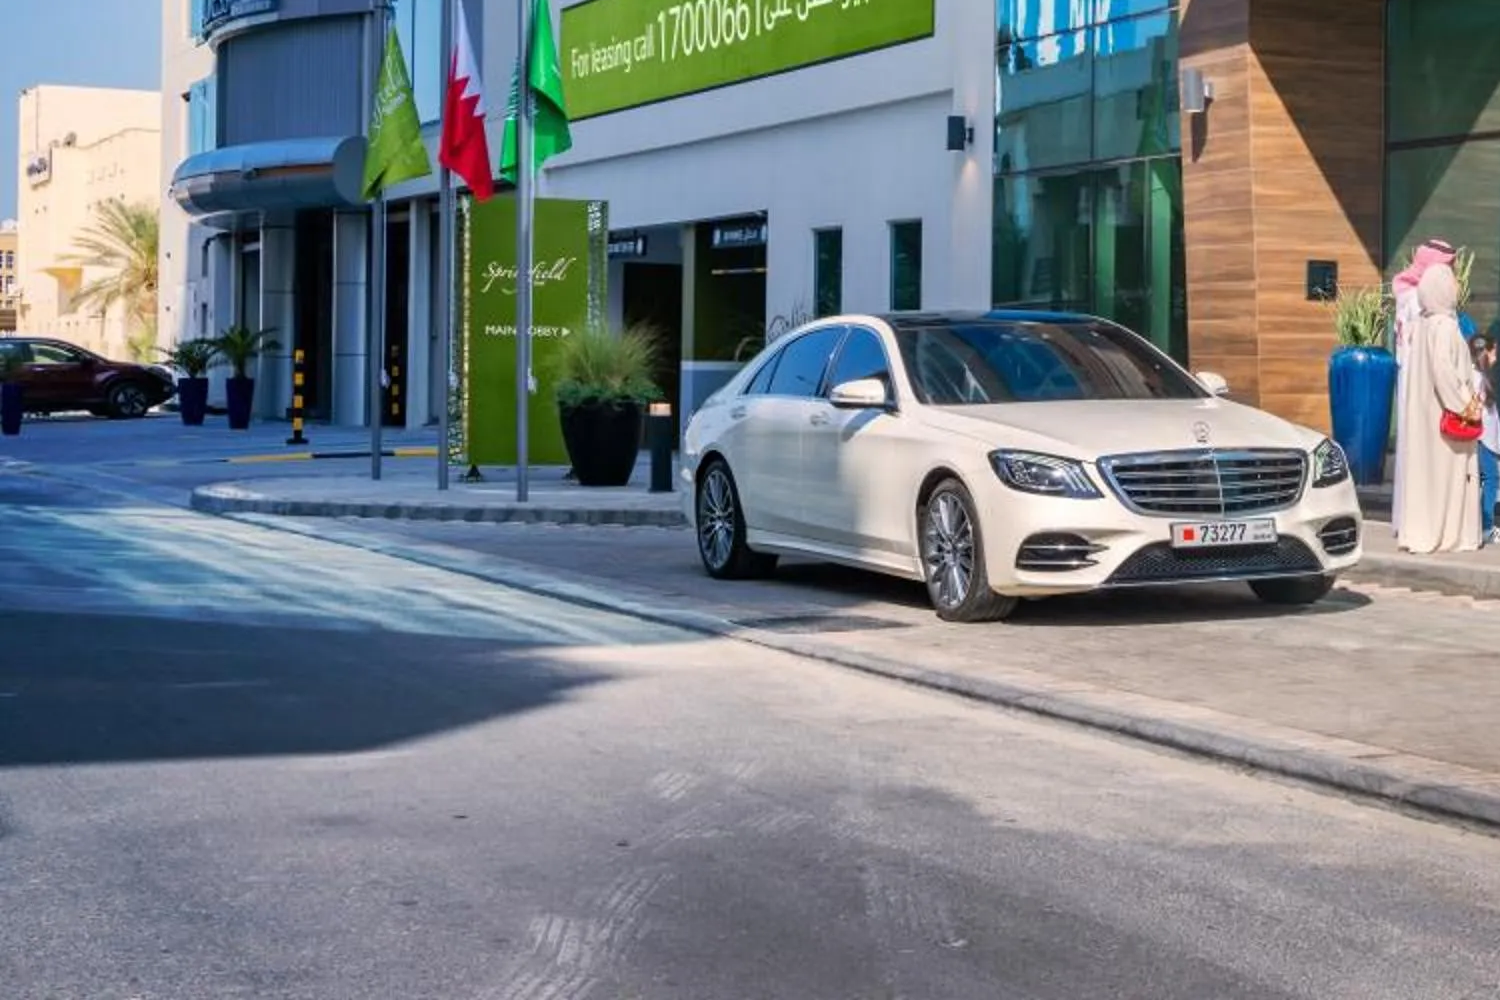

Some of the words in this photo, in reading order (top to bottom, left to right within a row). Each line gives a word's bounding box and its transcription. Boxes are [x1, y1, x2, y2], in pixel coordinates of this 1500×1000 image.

[571, 47, 590, 79] For
[591, 35, 632, 73] leasing
[633, 22, 655, 63] call
[480, 256, 577, 295] Sprifield
[485, 325, 517, 337] MAIN
[523, 325, 559, 337] OBBY
[1200, 524, 1247, 542] 73277
